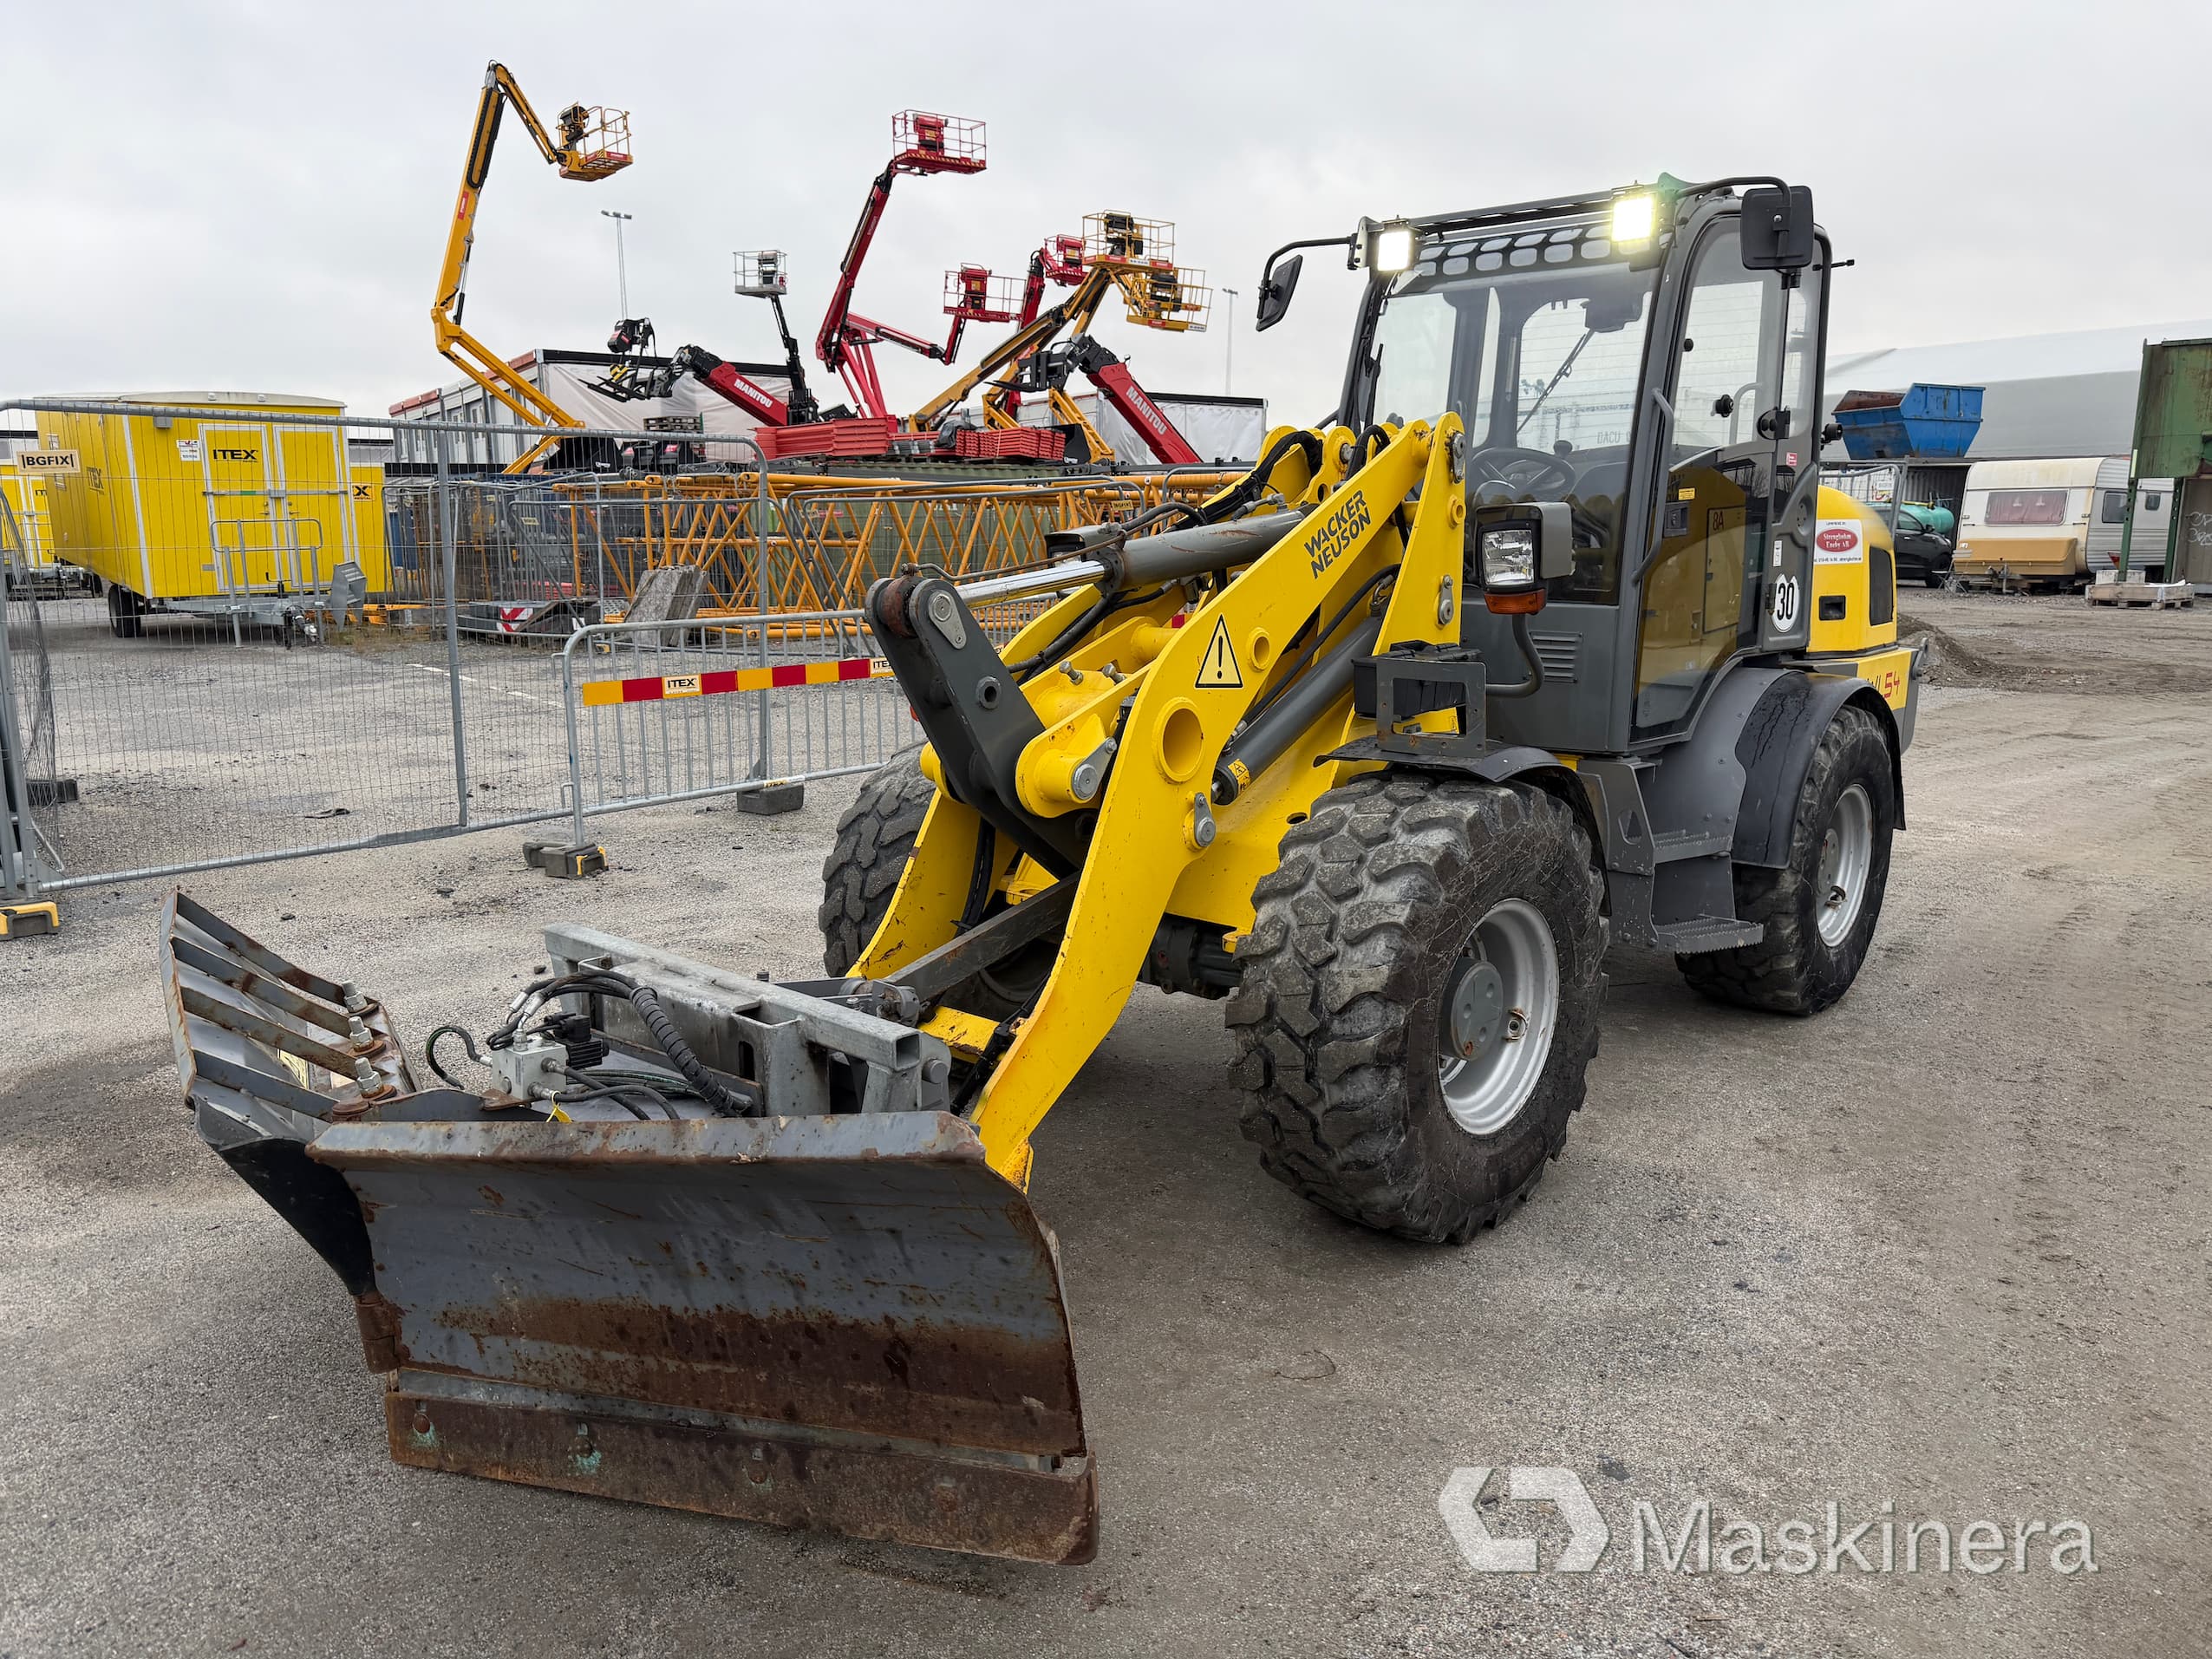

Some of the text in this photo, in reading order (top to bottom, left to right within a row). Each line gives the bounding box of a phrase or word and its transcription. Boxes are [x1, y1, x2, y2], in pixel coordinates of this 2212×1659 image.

[734, 378, 773, 408] MANITOU
[1126, 385, 1168, 435] MANITOU
[24, 455, 71, 467] BGFIX
[212, 449, 258, 460] ITEX
[1303, 490, 1367, 558] WACKER
[1310, 506, 1371, 580] NEUSON
[1777, 582, 1794, 620] 30
[873, 660, 891, 669] ITE
[668, 678, 696, 688] ITEX
